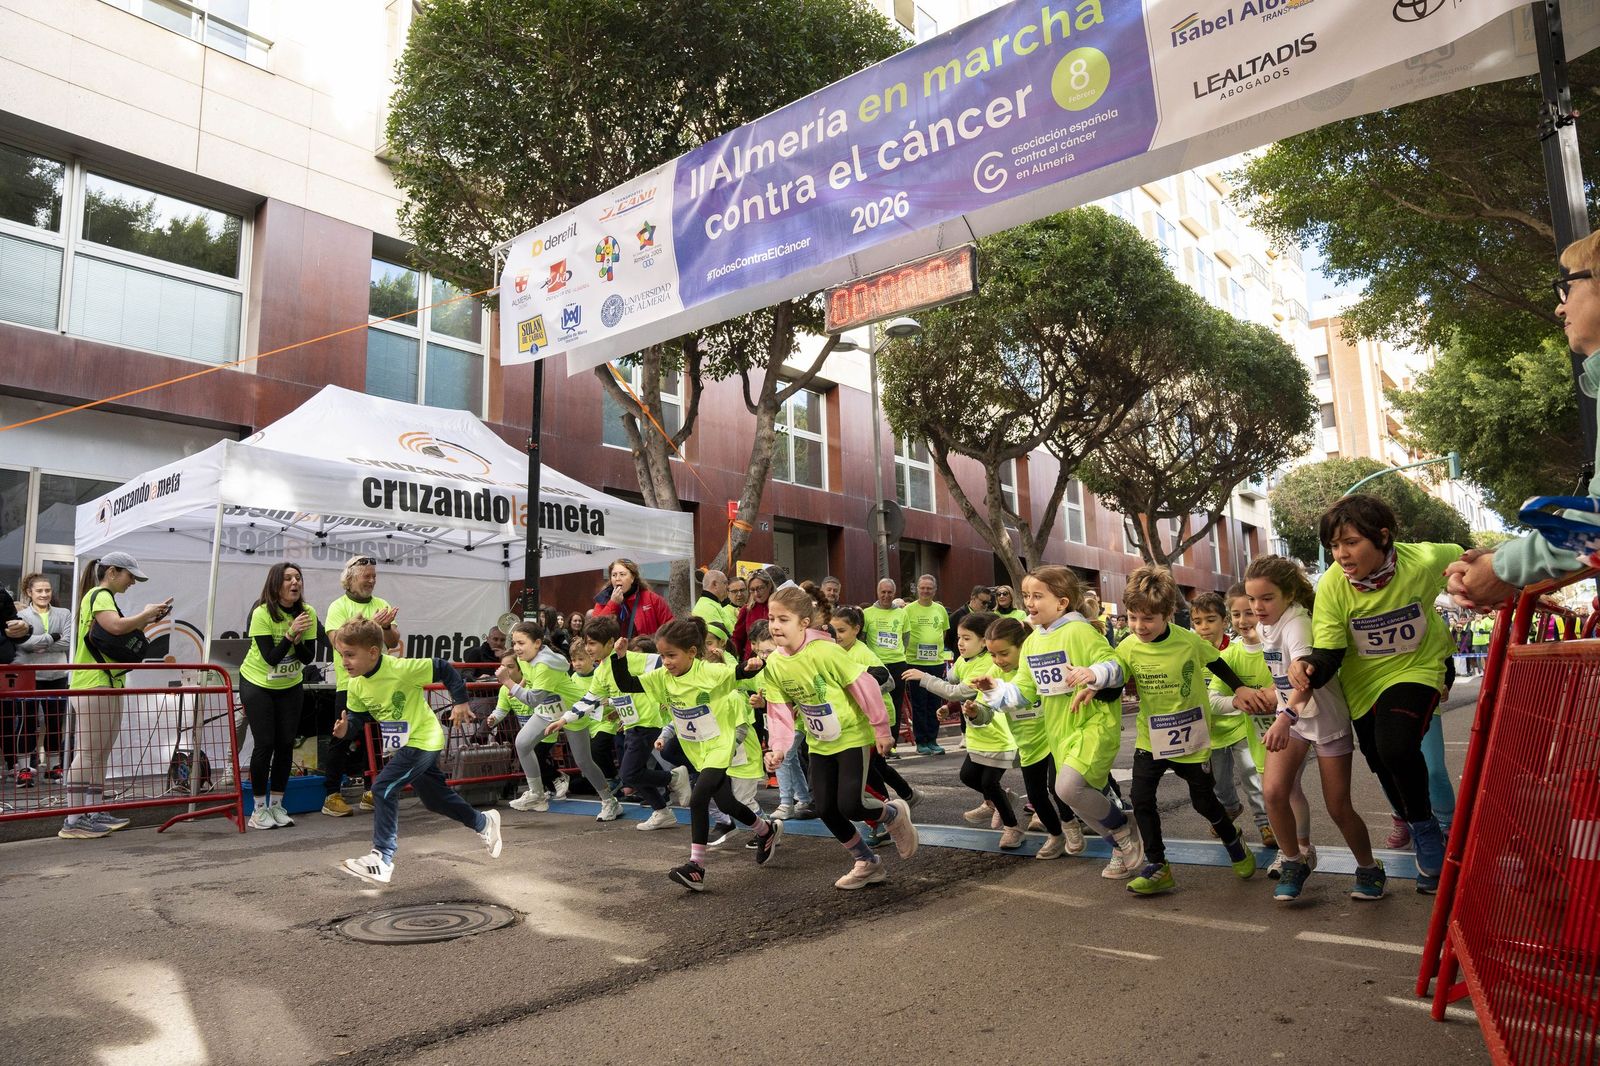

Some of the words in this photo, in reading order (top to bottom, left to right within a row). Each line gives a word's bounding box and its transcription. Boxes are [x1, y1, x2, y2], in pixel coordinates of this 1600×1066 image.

[1171, 8, 1234, 48] Isabel
[1239, 0, 1288, 21] Alo
[858, 81, 908, 124] en
[923, 0, 1105, 98] marcha
[1070, 58, 1090, 91] 8
[1193, 32, 1317, 100] LEALTADIS
[1220, 67, 1290, 101] ABOGADOS
[1011, 127, 1067, 155] asociación
[1069, 109, 1119, 133] española
[705, 173, 817, 240] contra
[828, 144, 868, 190] el
[877, 84, 1033, 171] cáncer
[1014, 148, 1047, 167] contra
[1049, 142, 1059, 154] el
[1060, 129, 1097, 150] cáncer
[1016, 169, 1030, 180] en
[1032, 152, 1075, 175] Almería
[850, 190, 910, 235] 2026
[706, 236, 811, 283] #TodosContraElCáncer
[624, 282, 672, 306] UNIVERSIDAD
[624, 306, 634, 316] DE
[635, 292, 672, 313] ALMERÍA
[113, 472, 182, 517] cruzandolameta
[879, 637, 898, 646] 1442
[1367, 623, 1416, 647] 570
[272, 661, 301, 674] 1800
[1033, 667, 1063, 685] 568
[686, 720, 697, 733] 4
[806, 717, 824, 732] 30
[1167, 725, 1192, 746] 27
[383, 735, 401, 749] 78
